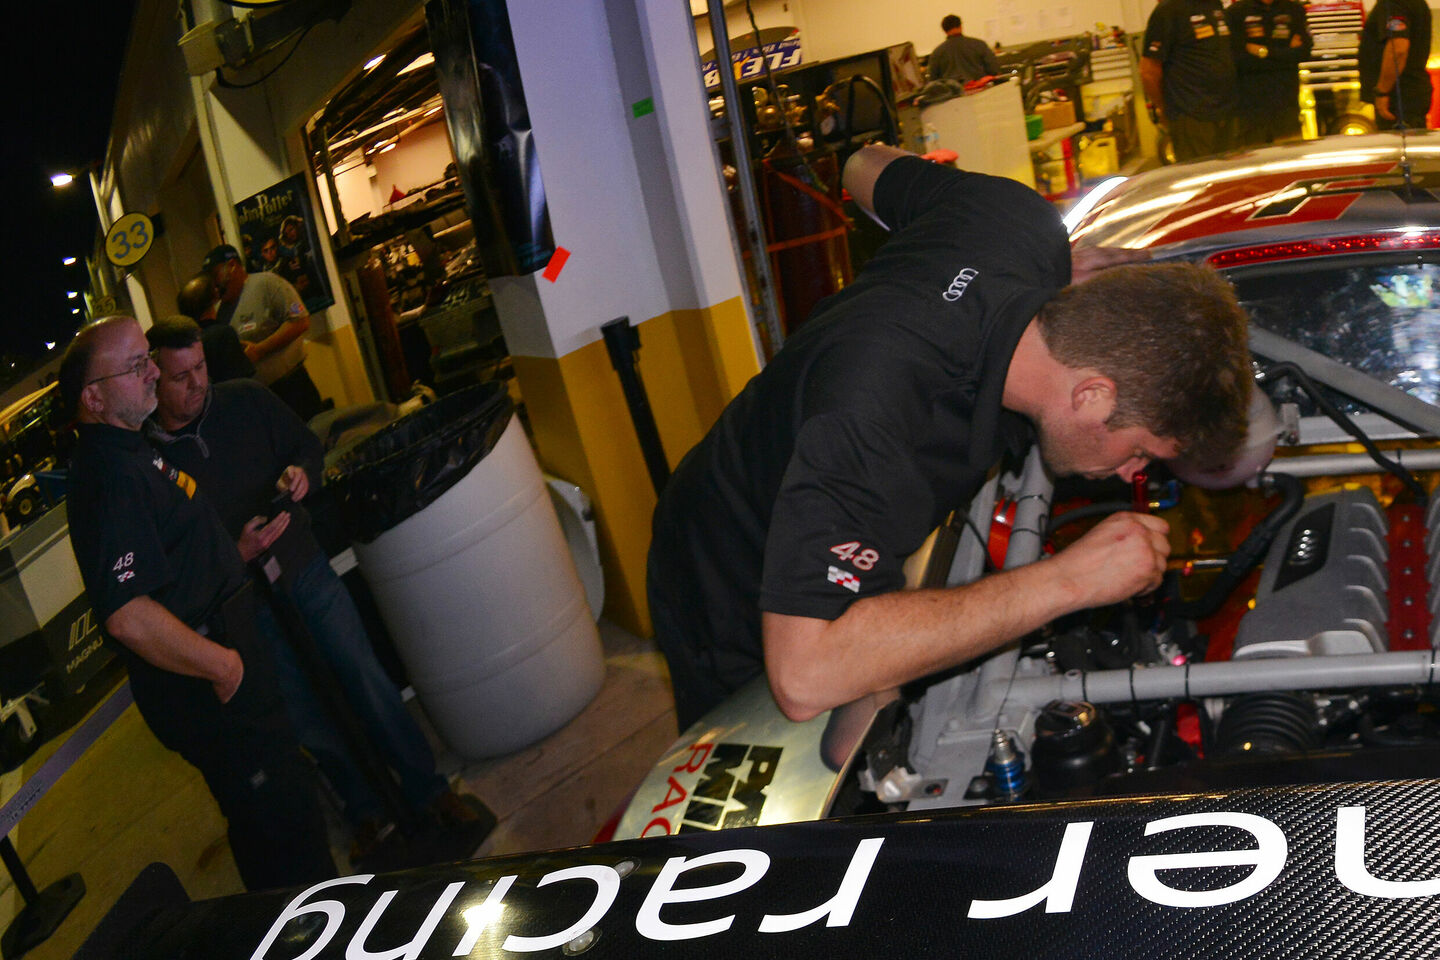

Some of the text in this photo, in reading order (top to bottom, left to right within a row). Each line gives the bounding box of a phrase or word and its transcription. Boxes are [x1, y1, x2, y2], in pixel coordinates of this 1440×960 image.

[112, 221, 148, 259] 33
[112, 552, 135, 571] 48
[829, 540, 880, 572] 48
[66, 634, 104, 674] MAGNU
